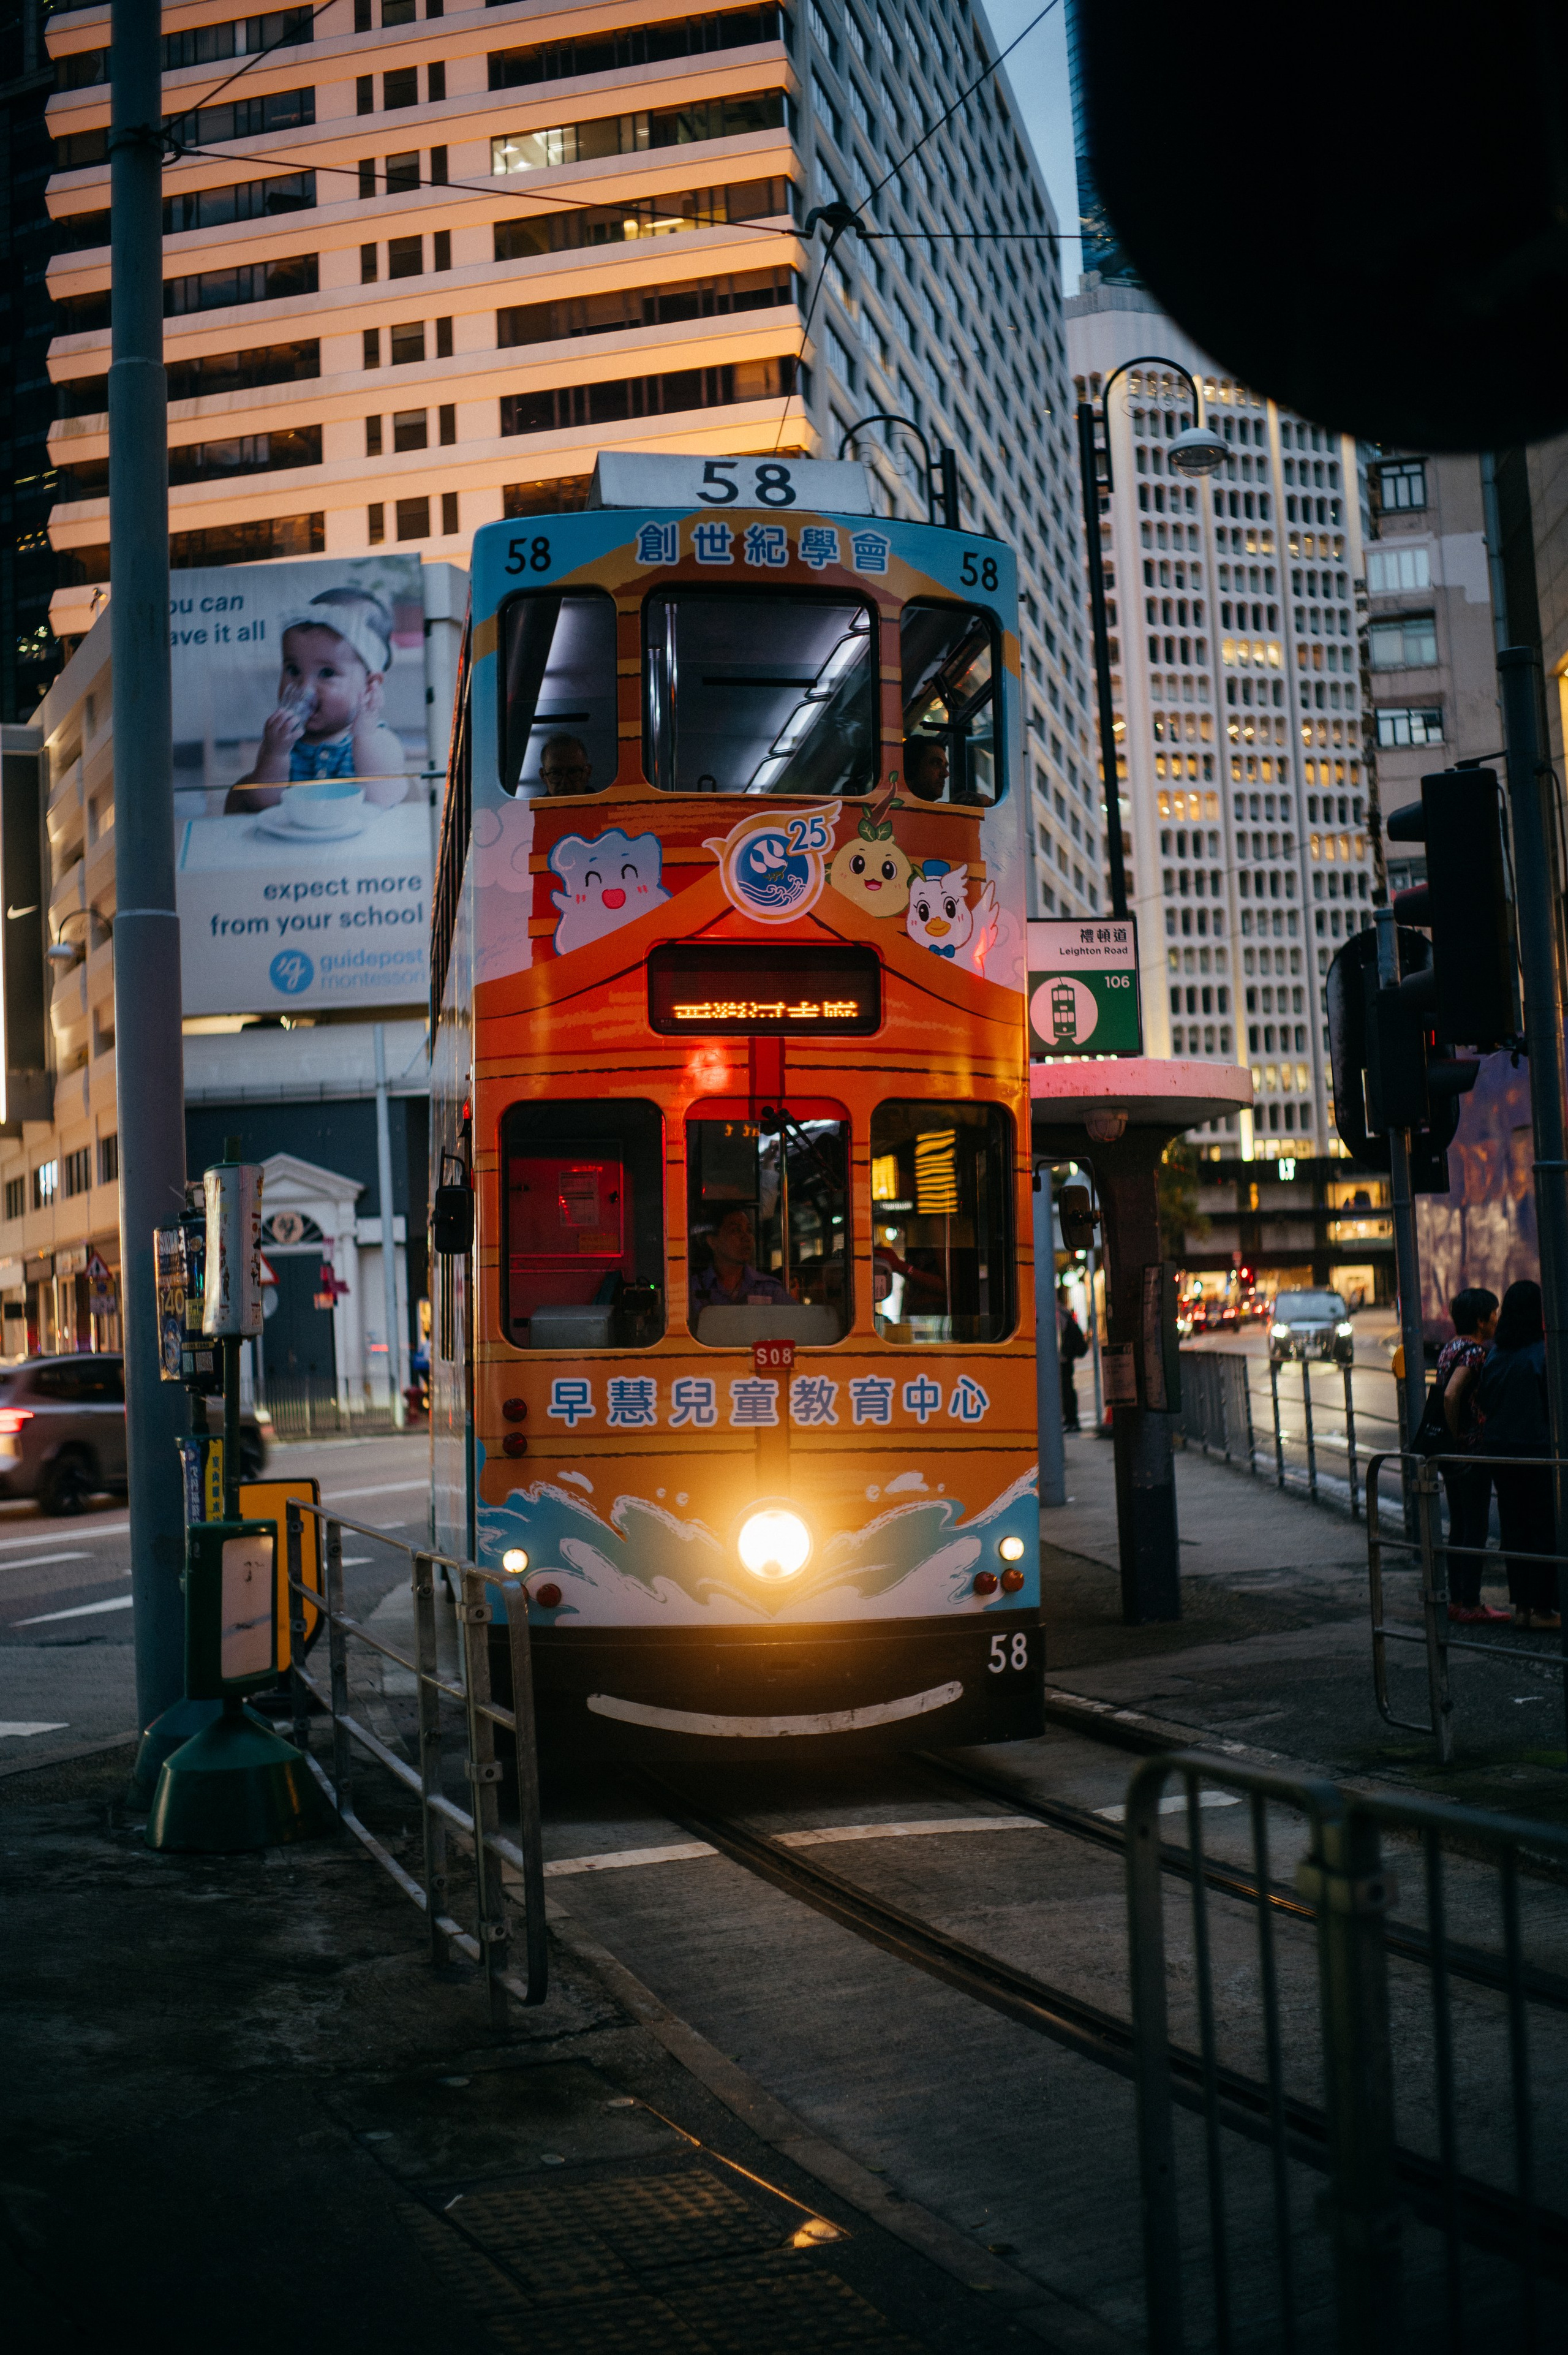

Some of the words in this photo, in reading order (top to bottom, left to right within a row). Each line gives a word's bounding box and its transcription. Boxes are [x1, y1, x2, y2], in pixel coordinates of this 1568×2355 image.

[696, 461, 797, 507] 58
[505, 536, 552, 575] 58
[636, 522, 891, 574] 創世紀學會
[959, 551, 999, 592] 58
[170, 598, 194, 615] ou
[200, 594, 244, 613] can
[170, 628, 208, 646] ave
[214, 622, 231, 643] it
[236, 619, 265, 641] all
[790, 817, 826, 852] 25
[263, 877, 350, 903] expect
[356, 875, 423, 894] more
[211, 913, 270, 937] from
[276, 912, 333, 937] your
[339, 902, 424, 929] school
[1080, 928, 1128, 943] 禮頓道
[320, 948, 424, 973] guidepost
[1060, 947, 1101, 956] Leighton
[1104, 976, 1130, 988] 106
[756, 1347, 793, 1366] S08
[548, 1374, 988, 1427] 早慧兒童教育中心
[987, 1633, 1028, 1673] 58
